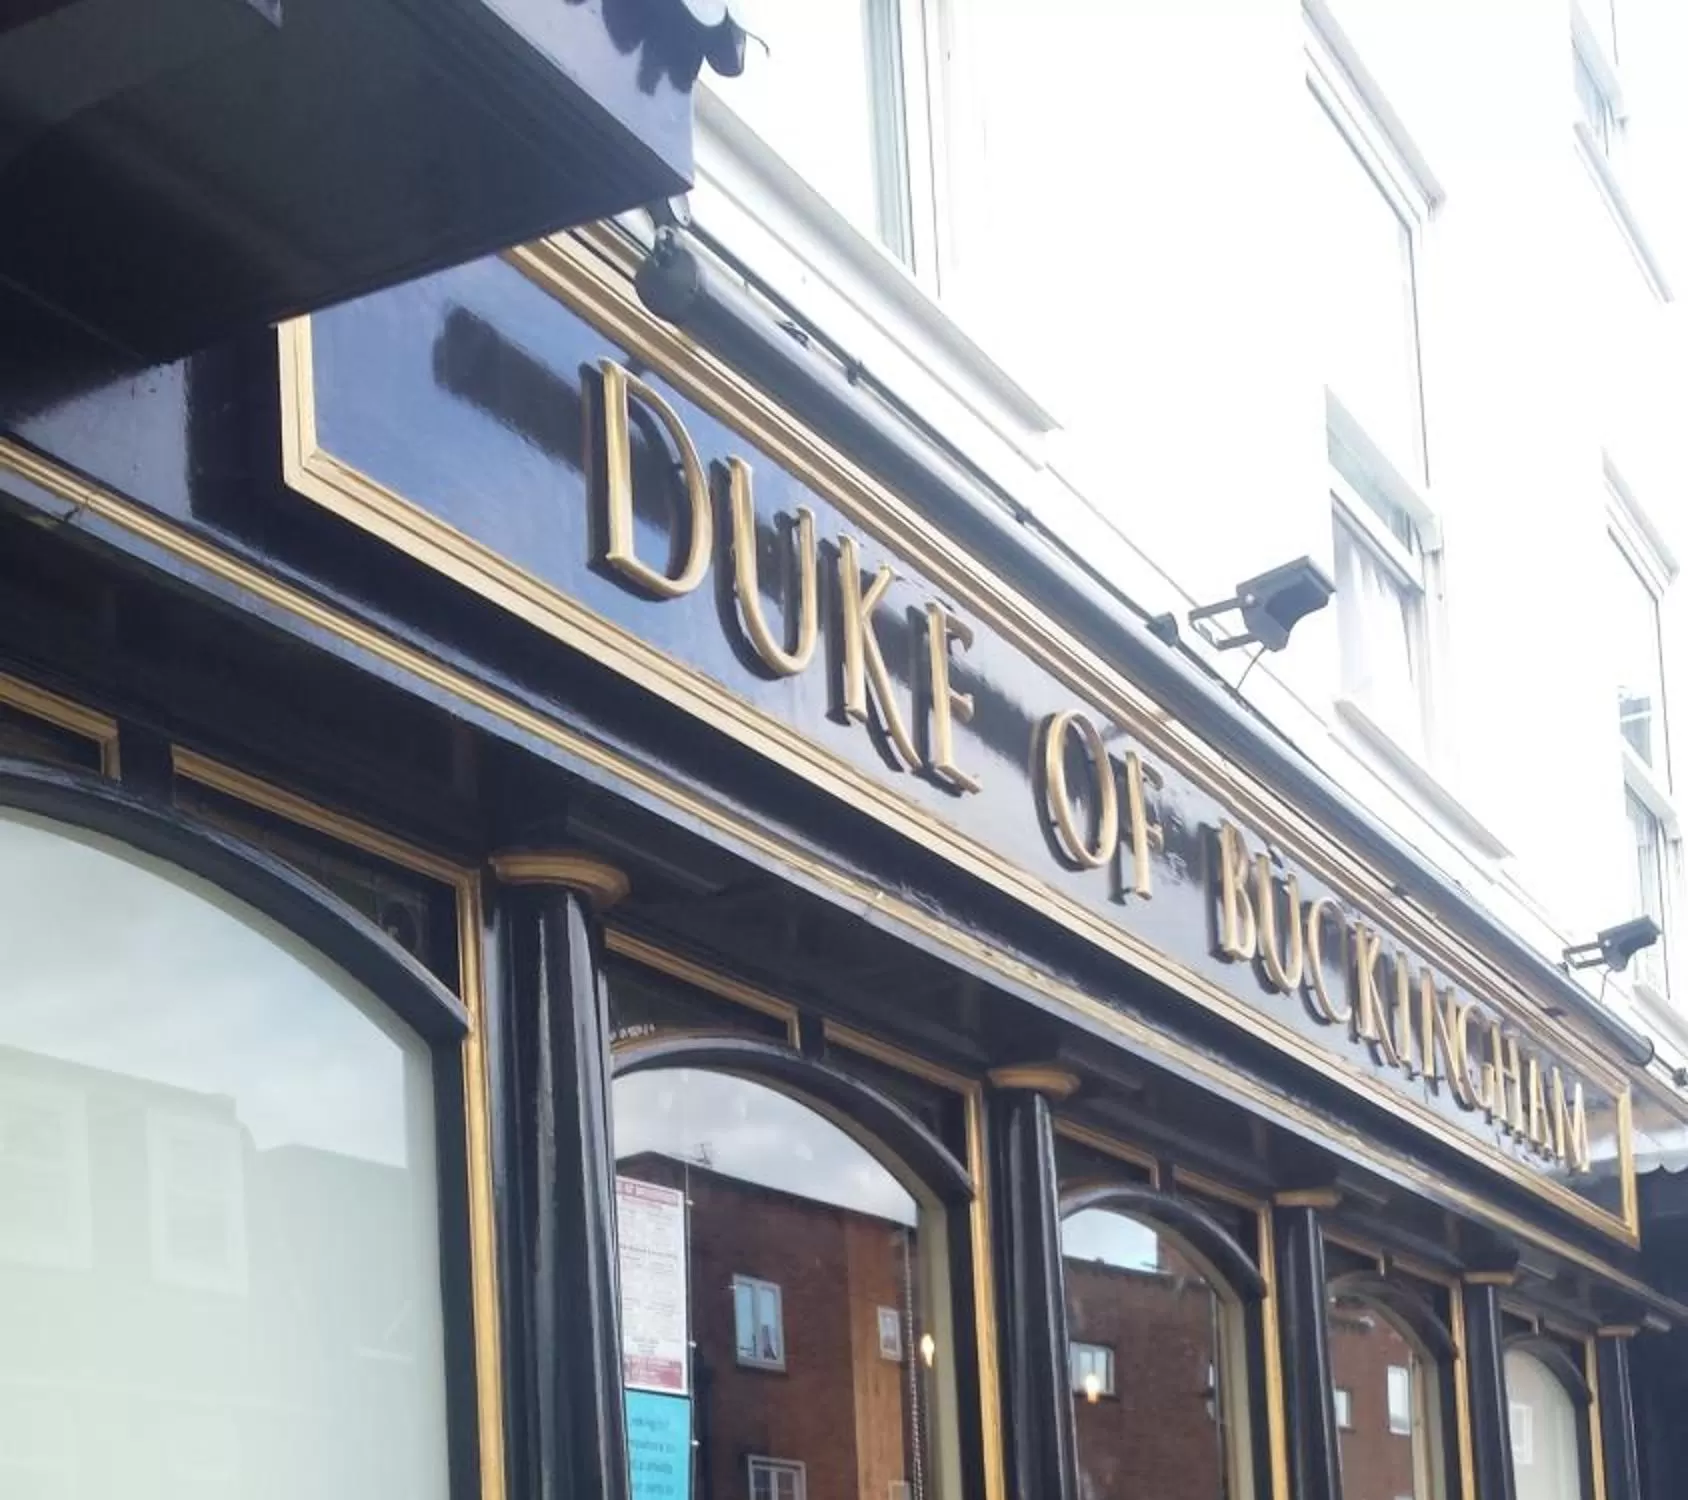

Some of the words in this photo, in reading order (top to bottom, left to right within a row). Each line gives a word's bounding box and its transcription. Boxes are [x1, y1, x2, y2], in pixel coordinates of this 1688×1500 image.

[588, 356, 984, 796] DUKE
[1038, 709, 1164, 901] OF
[1214, 817, 1591, 1174] BUCKINGHAM
